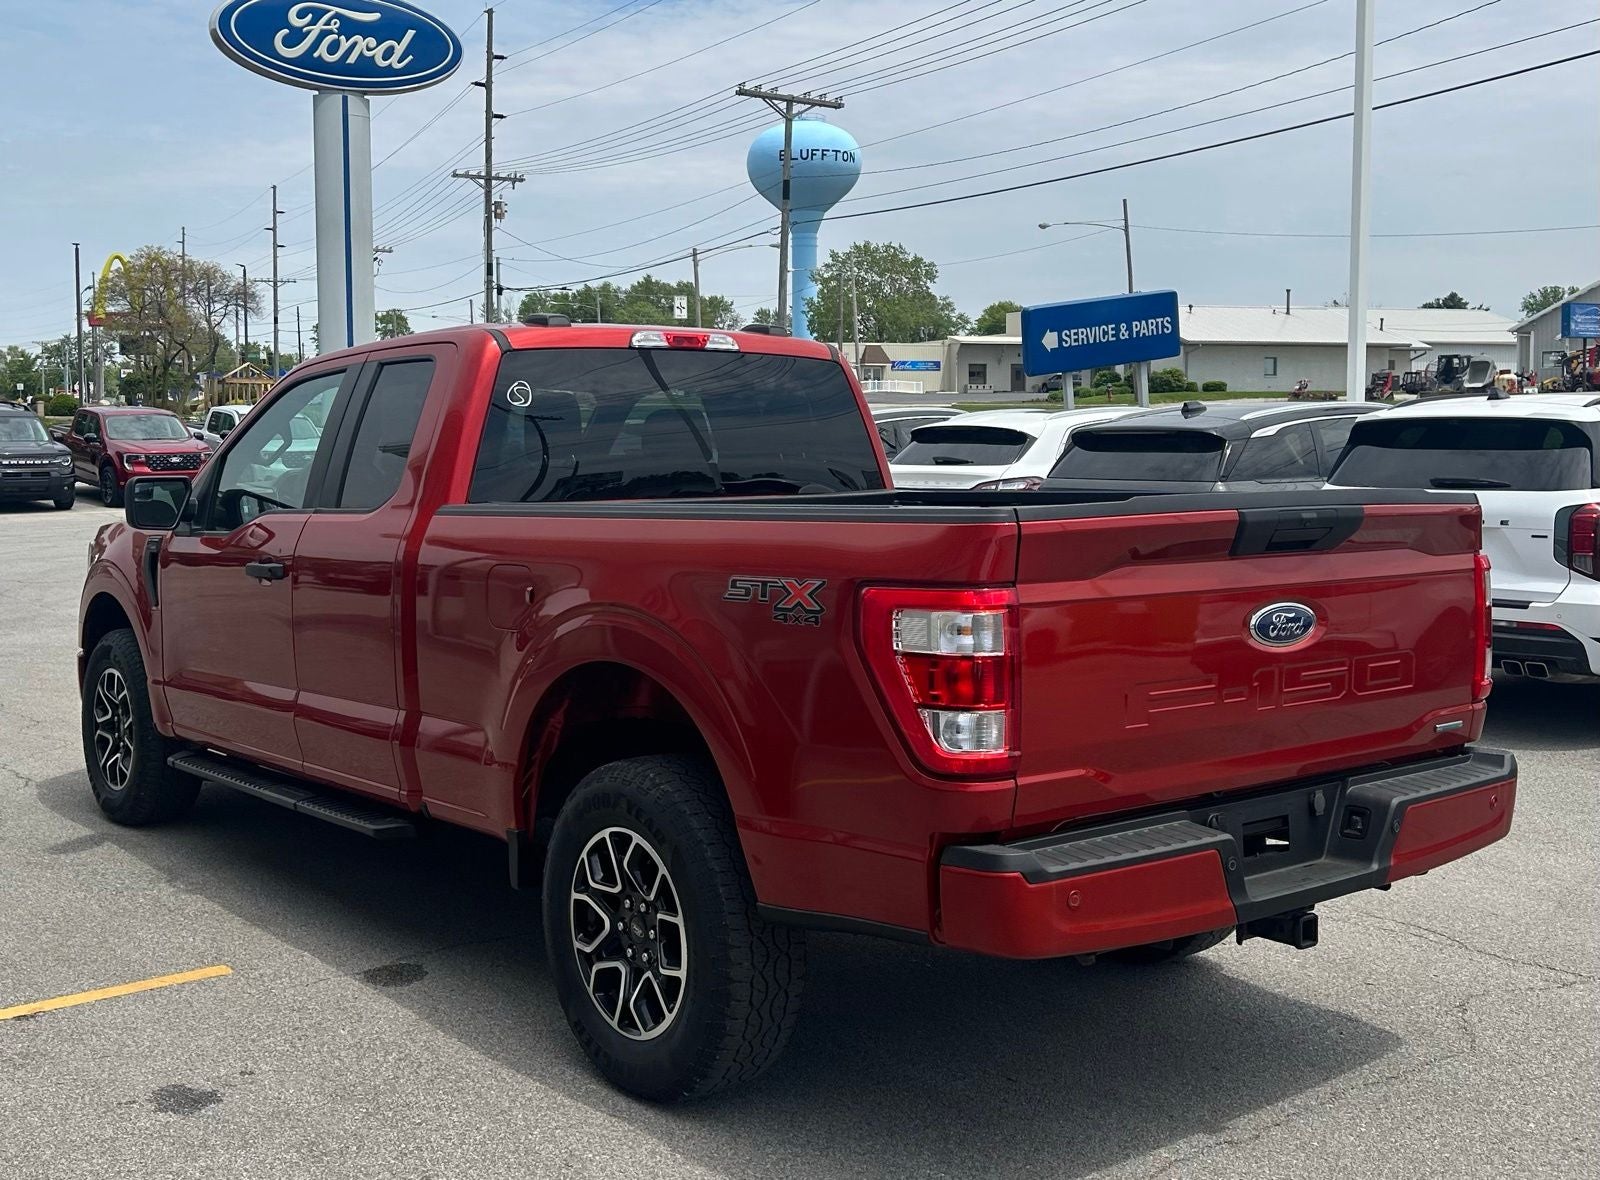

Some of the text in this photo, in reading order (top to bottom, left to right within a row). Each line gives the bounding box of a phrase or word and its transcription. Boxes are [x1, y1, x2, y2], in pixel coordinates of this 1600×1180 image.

[273, 2, 416, 69] Ford
[778, 148, 856, 163] BLUFFTON
[1061, 316, 1172, 348] SERVICE & PARTS
[722, 574, 828, 616] STX
[1269, 612, 1304, 638] Ford
[1123, 649, 1416, 729] F-150
